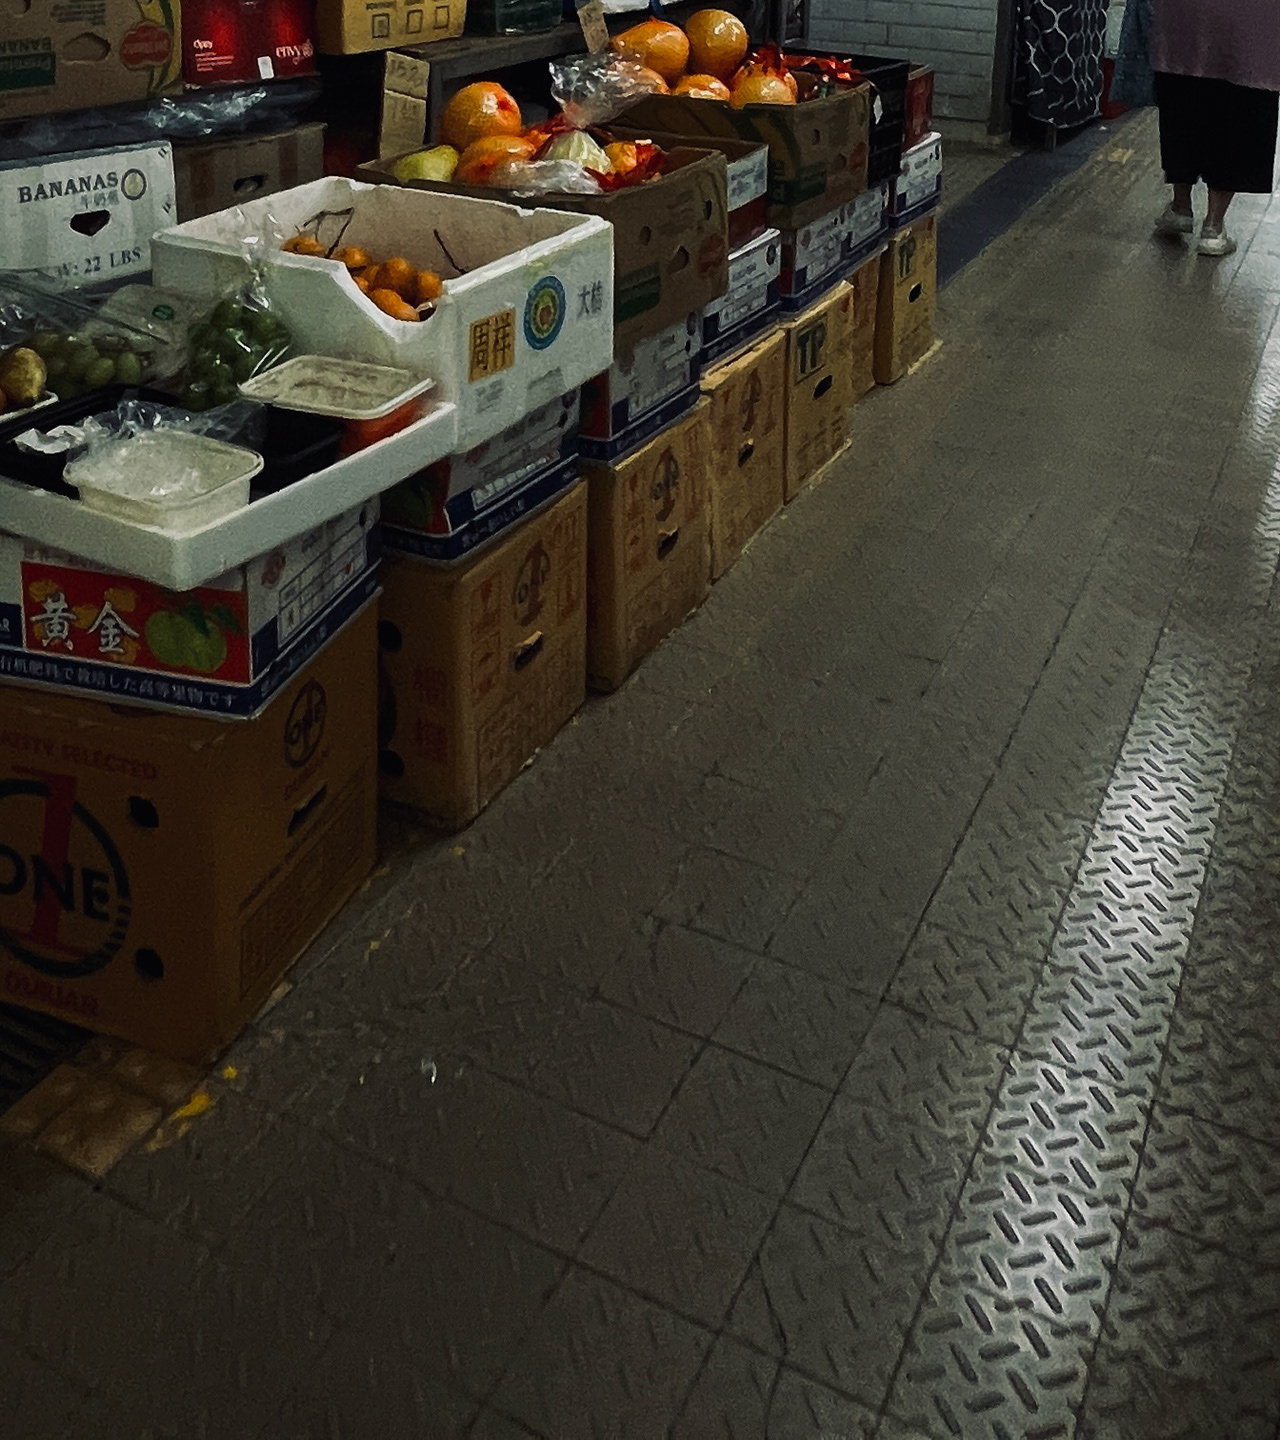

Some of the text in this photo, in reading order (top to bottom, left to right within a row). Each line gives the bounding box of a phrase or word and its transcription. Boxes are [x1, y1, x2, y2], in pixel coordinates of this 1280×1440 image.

[18, 171, 119, 203] BANANAS
[110, 246, 142, 267] LBS
[29, 591, 142, 654] 黄金
